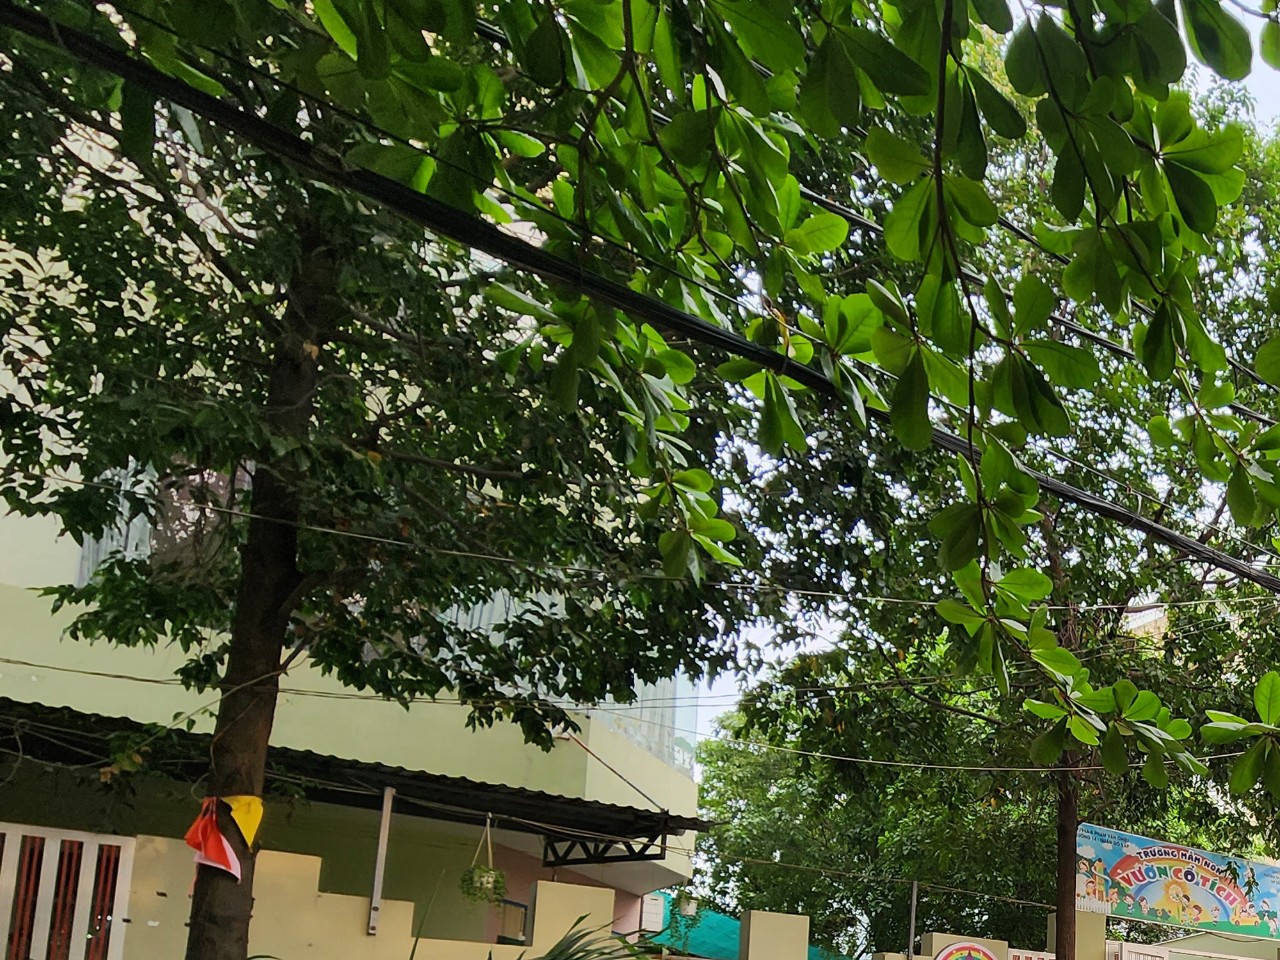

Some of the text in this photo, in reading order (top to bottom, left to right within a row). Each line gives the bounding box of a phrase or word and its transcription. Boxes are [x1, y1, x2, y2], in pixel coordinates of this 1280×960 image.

[1117, 862, 1241, 908] VƯỜN CỔ TÍCH
